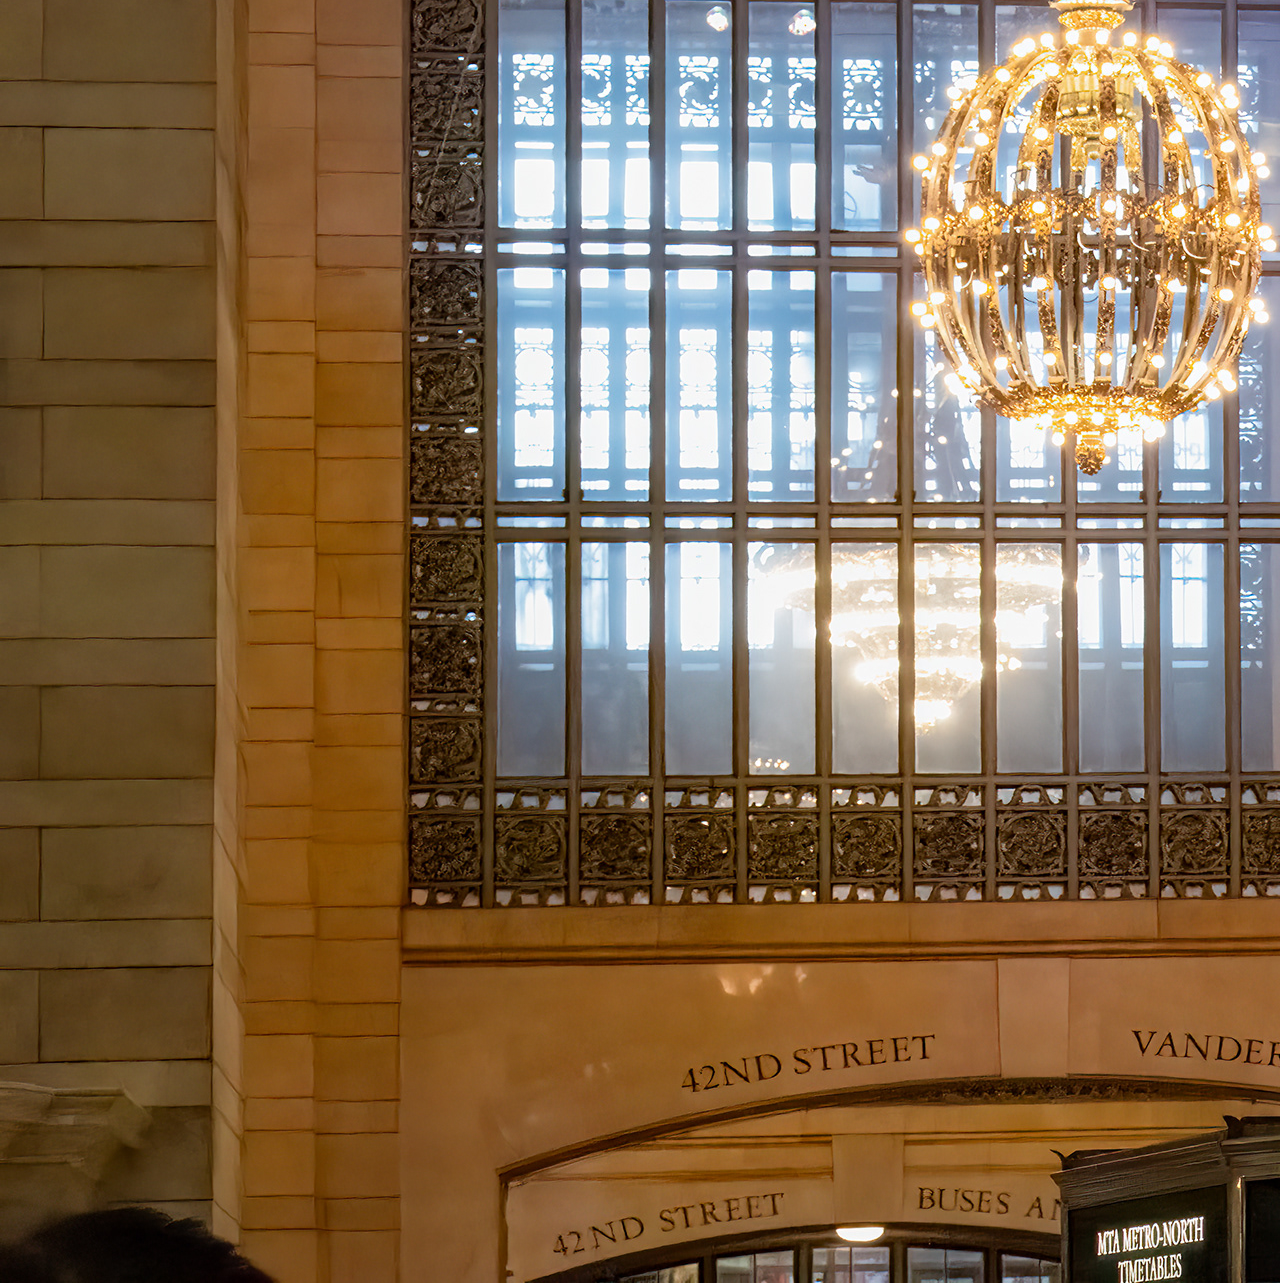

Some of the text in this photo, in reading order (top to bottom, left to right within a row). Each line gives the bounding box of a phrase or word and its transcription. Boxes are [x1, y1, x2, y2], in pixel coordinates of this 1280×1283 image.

[681, 1033, 937, 1094] 42ND STREET
[918, 1186, 1012, 1216] BUSES
[553, 1192, 786, 1257] 42ND STREET
[1097, 1215, 1206, 1257] MTA METRO-NORTH
[1117, 1252, 1183, 1283] TIMETABLES
